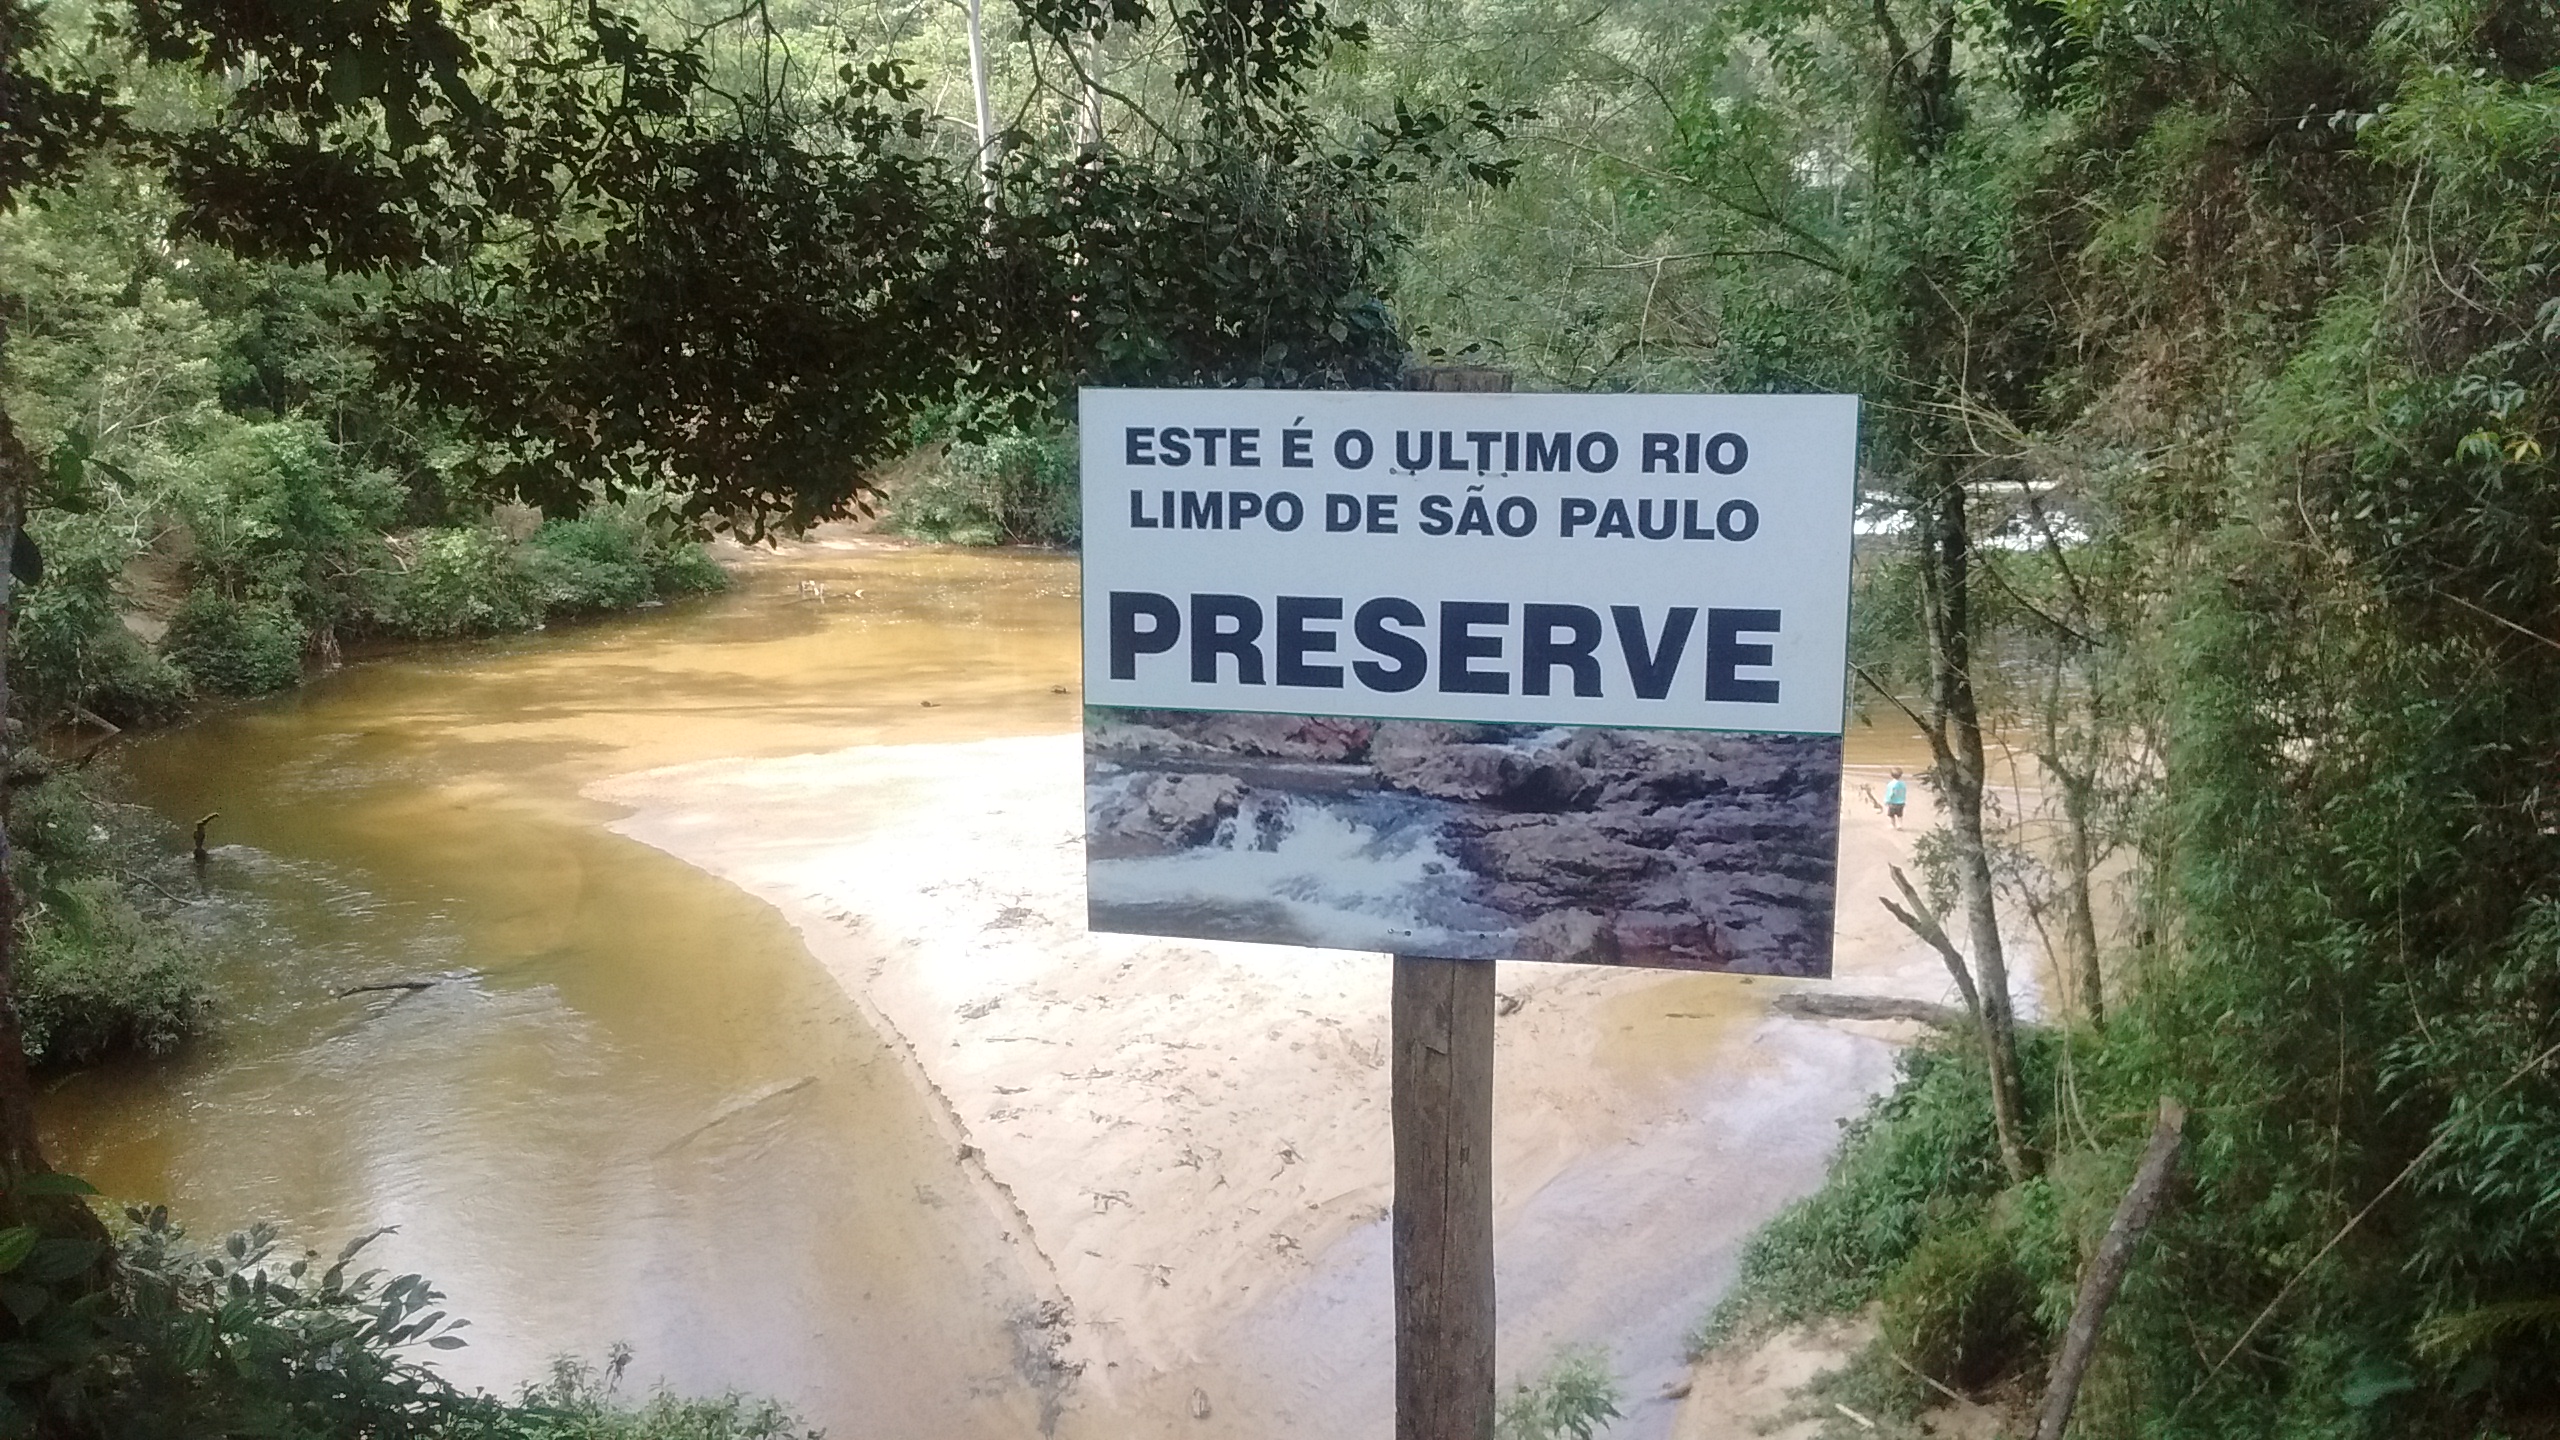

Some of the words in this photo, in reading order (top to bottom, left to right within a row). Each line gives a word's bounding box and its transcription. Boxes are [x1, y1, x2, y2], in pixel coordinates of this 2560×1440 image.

[1125, 427, 1261, 468] ESTE
[1282, 416, 1314, 469] É
[1334, 429, 1374, 470] O
[1396, 430, 1619, 474] ULTIMO
[1641, 432, 1749, 475] RIO
[1130, 489, 1304, 532] LIMPO
[1325, 493, 1399, 534] DE
[1418, 484, 1538, 538] SÃO
[1560, 497, 1759, 542] PAULO
[1109, 591, 1782, 704] PRESERVE
